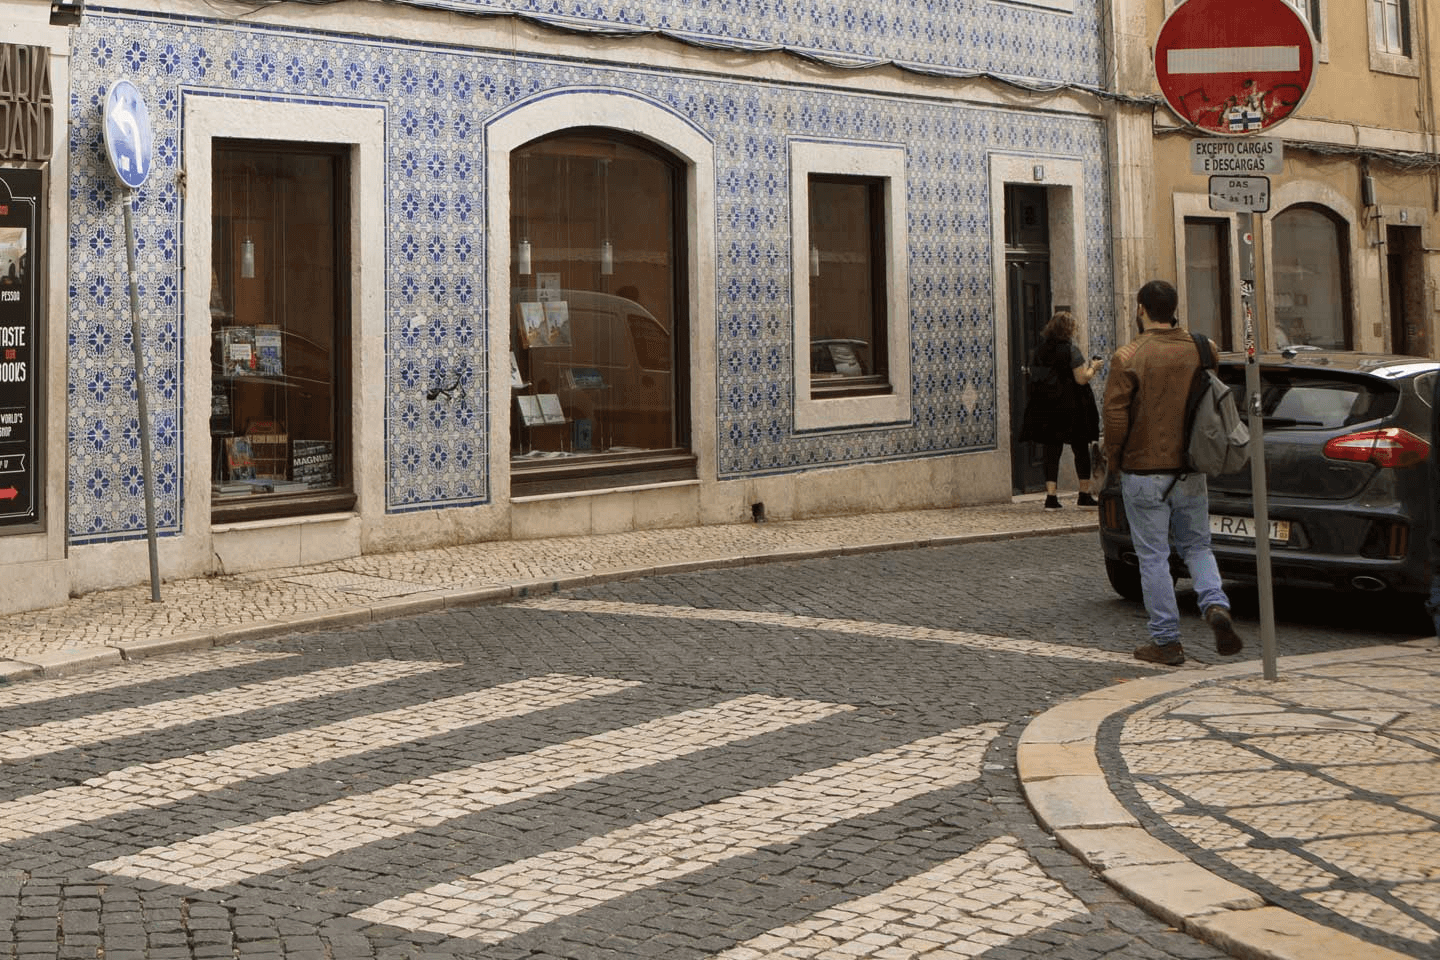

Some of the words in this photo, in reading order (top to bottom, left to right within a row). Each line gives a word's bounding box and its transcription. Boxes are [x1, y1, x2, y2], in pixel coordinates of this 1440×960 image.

[1196, 142, 1235, 155] EXCEPTO
[1237, 142, 1273, 154] CARGAS
[1204, 159, 1210, 171] E
[1213, 158, 1265, 171] DESCARGAS
[1228, 180, 1249, 189] DAS
[1243, 195, 1254, 206] 11
[1, 290, 21, 301] PESSOA
[0, 412, 23, 424] WORLD'S
[293, 453, 334, 467] MAGNUM
[1221, 517, 1248, 535] RA
